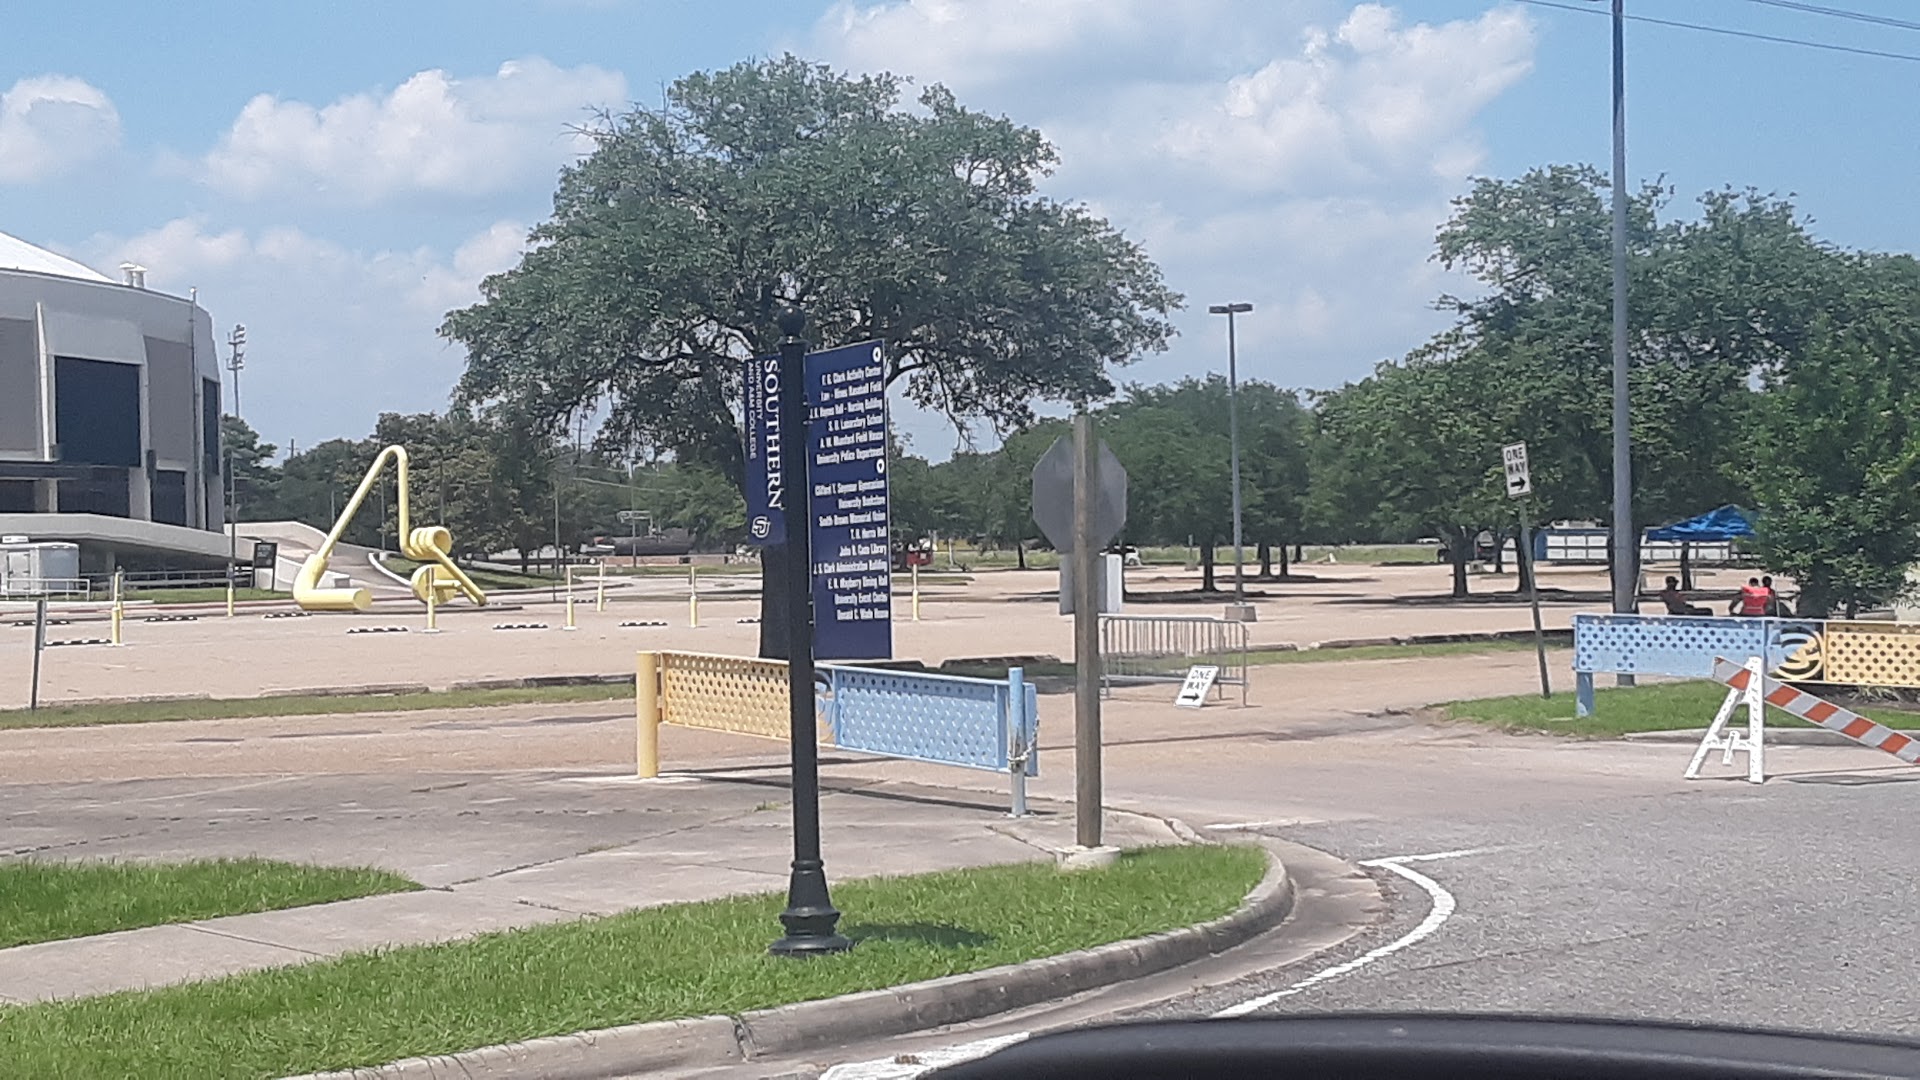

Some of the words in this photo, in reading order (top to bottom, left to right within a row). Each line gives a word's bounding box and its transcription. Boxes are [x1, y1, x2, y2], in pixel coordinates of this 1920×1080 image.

[755, 361, 763, 420] UNIVERSITY
[867, 413, 883, 426] School
[749, 410, 757, 459] COLLEGE
[764, 360, 781, 508] SOUTHERN
[841, 450, 855, 461] Police
[1506, 446, 1524, 462] ONE
[1508, 461, 1525, 475] WAY
[870, 543, 886, 555] Library
[1191, 670, 1211, 680] ONE
[1186, 682, 1208, 690] WAY
